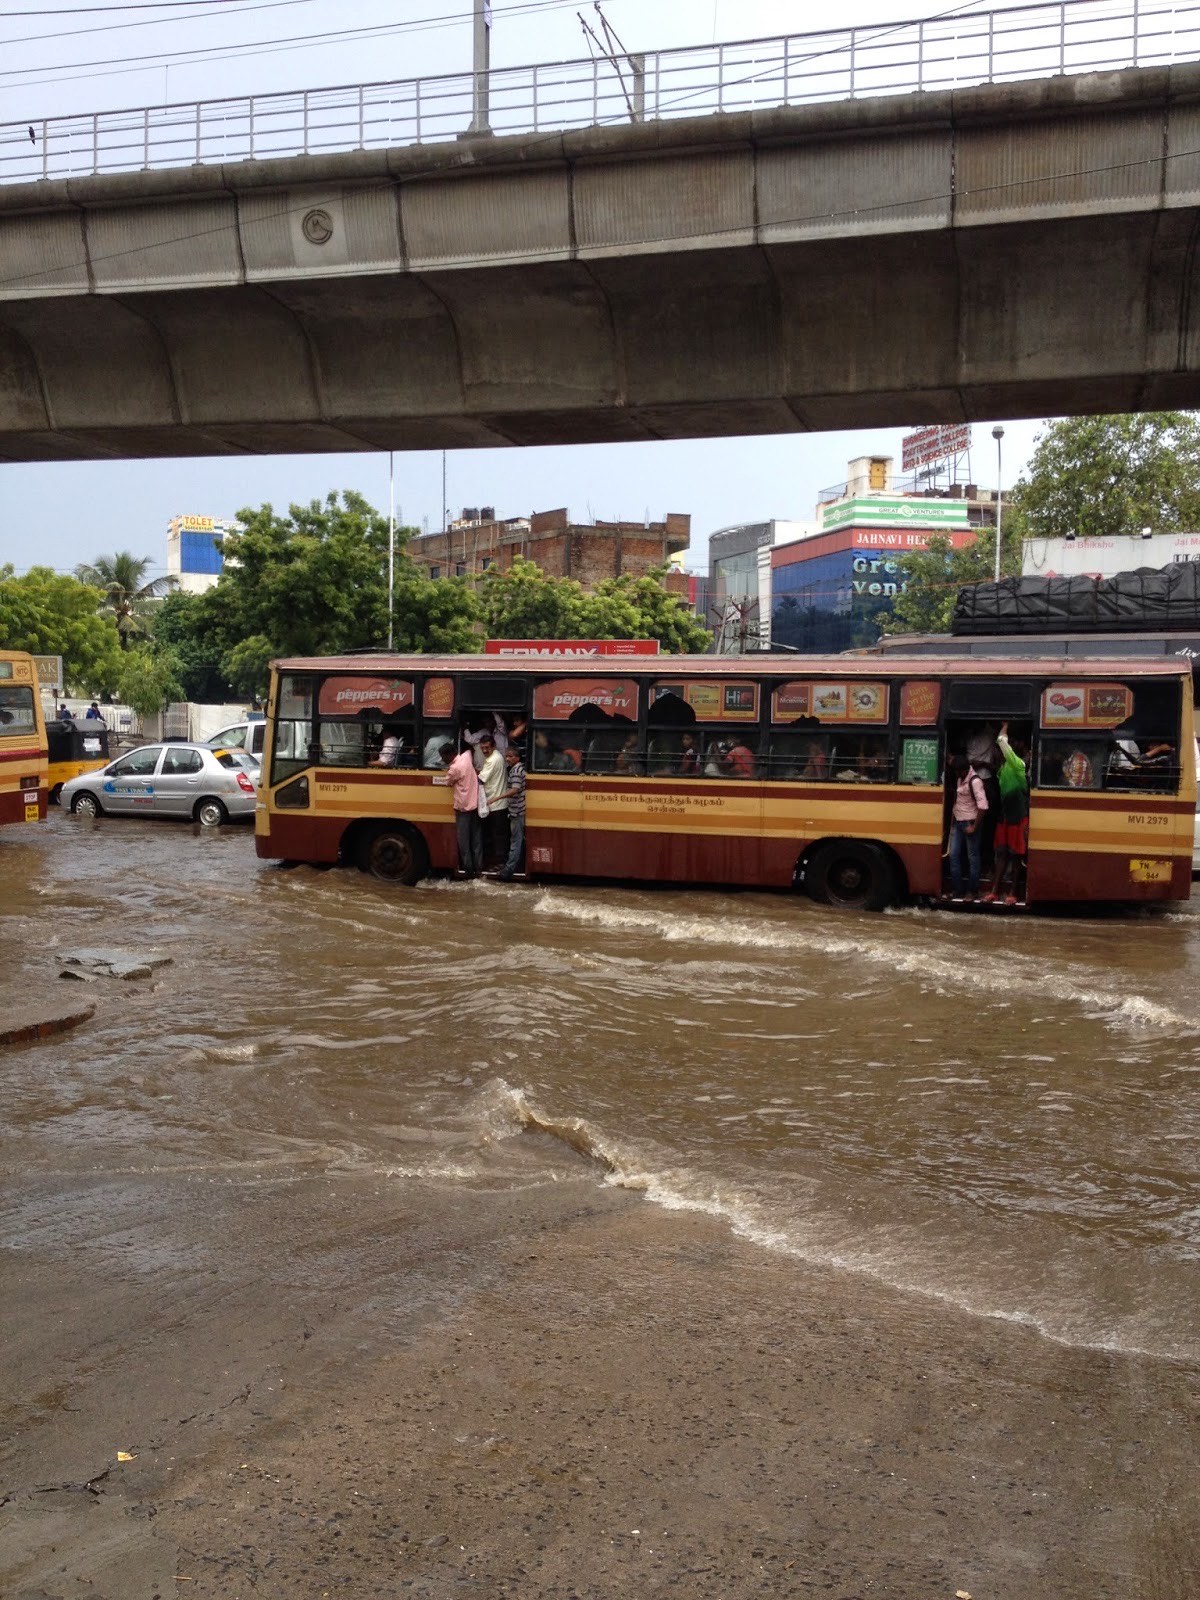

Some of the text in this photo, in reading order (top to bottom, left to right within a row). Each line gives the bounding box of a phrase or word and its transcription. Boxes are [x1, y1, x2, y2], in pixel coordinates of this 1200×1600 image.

[857, 533, 902, 545] JAHNAVI
[391, 692, 407, 701] TV
[909, 686, 928, 697] turn
[614, 698, 630, 708] TV
[332, 784, 348, 793] 2979
[1128, 815, 1169, 825] MVI 2979
